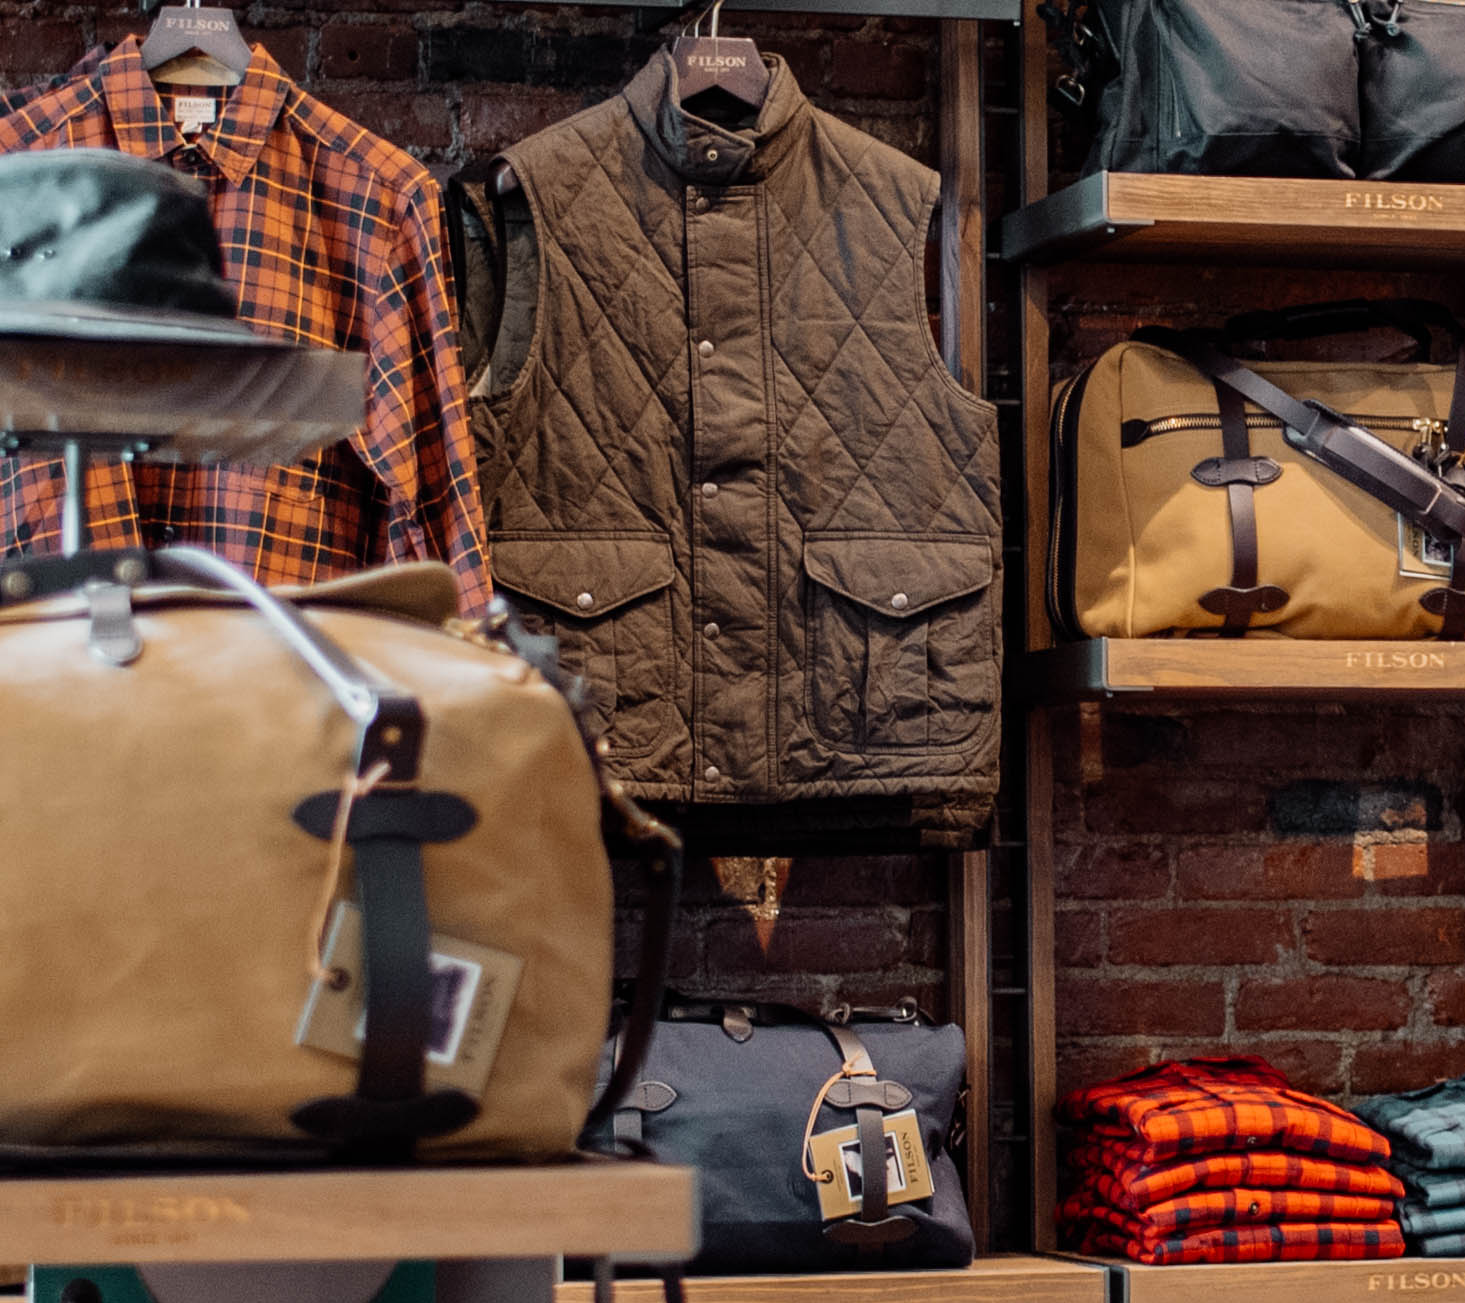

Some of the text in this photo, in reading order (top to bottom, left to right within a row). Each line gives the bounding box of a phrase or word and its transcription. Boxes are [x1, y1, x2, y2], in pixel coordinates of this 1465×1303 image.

[165, 17, 231, 32] FILSON
[687, 55, 747, 68] FILSON
[1344, 192, 1444, 211] FILSON
[1344, 650, 1446, 670] FILSON
[900, 1132, 919, 1185] FILSON
